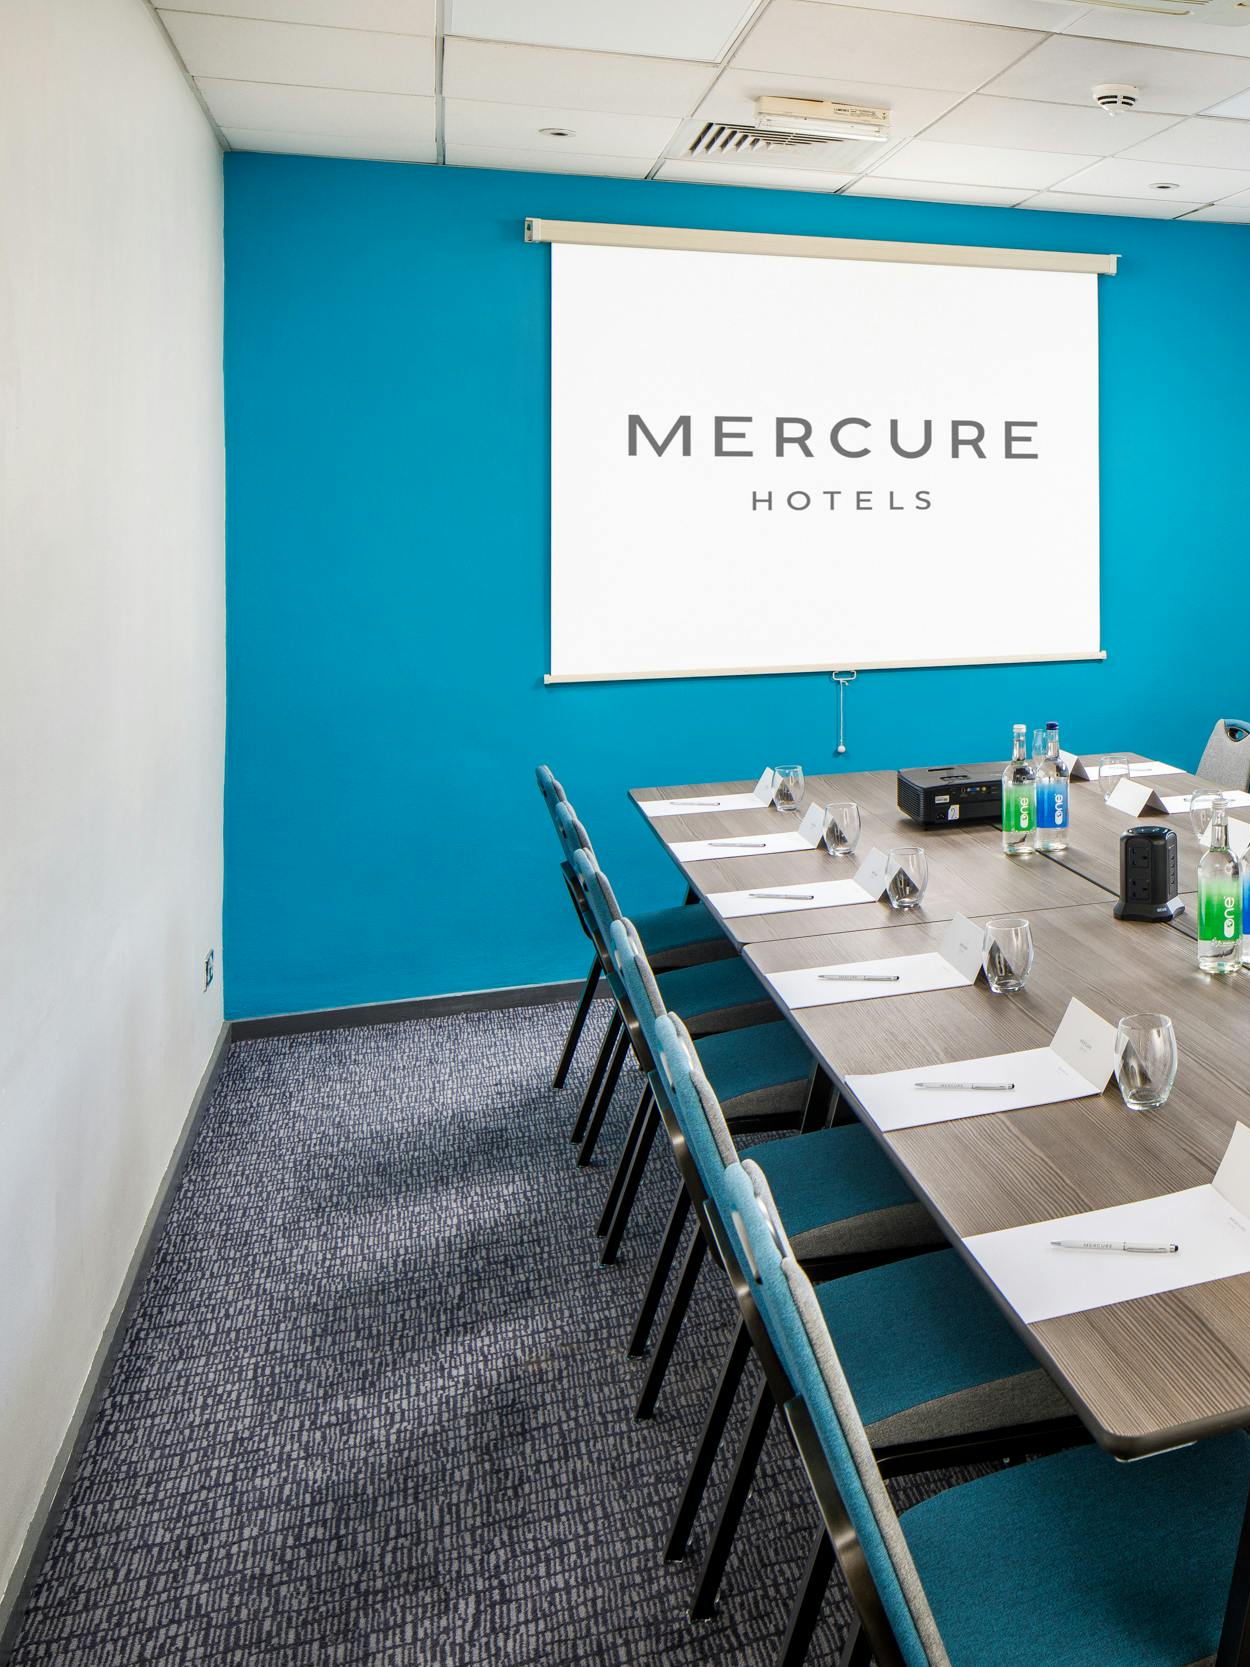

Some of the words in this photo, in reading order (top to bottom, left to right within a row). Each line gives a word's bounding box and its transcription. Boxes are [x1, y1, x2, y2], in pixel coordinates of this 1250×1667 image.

[627, 414, 1039, 460] MERCURE
[752, 490, 932, 511] HOTELS
[1020, 796, 1029, 829] one
[1055, 793, 1063, 825] one
[1223, 896, 1235, 938] one
[1082, 1241, 1112, 1249] MERCURE
